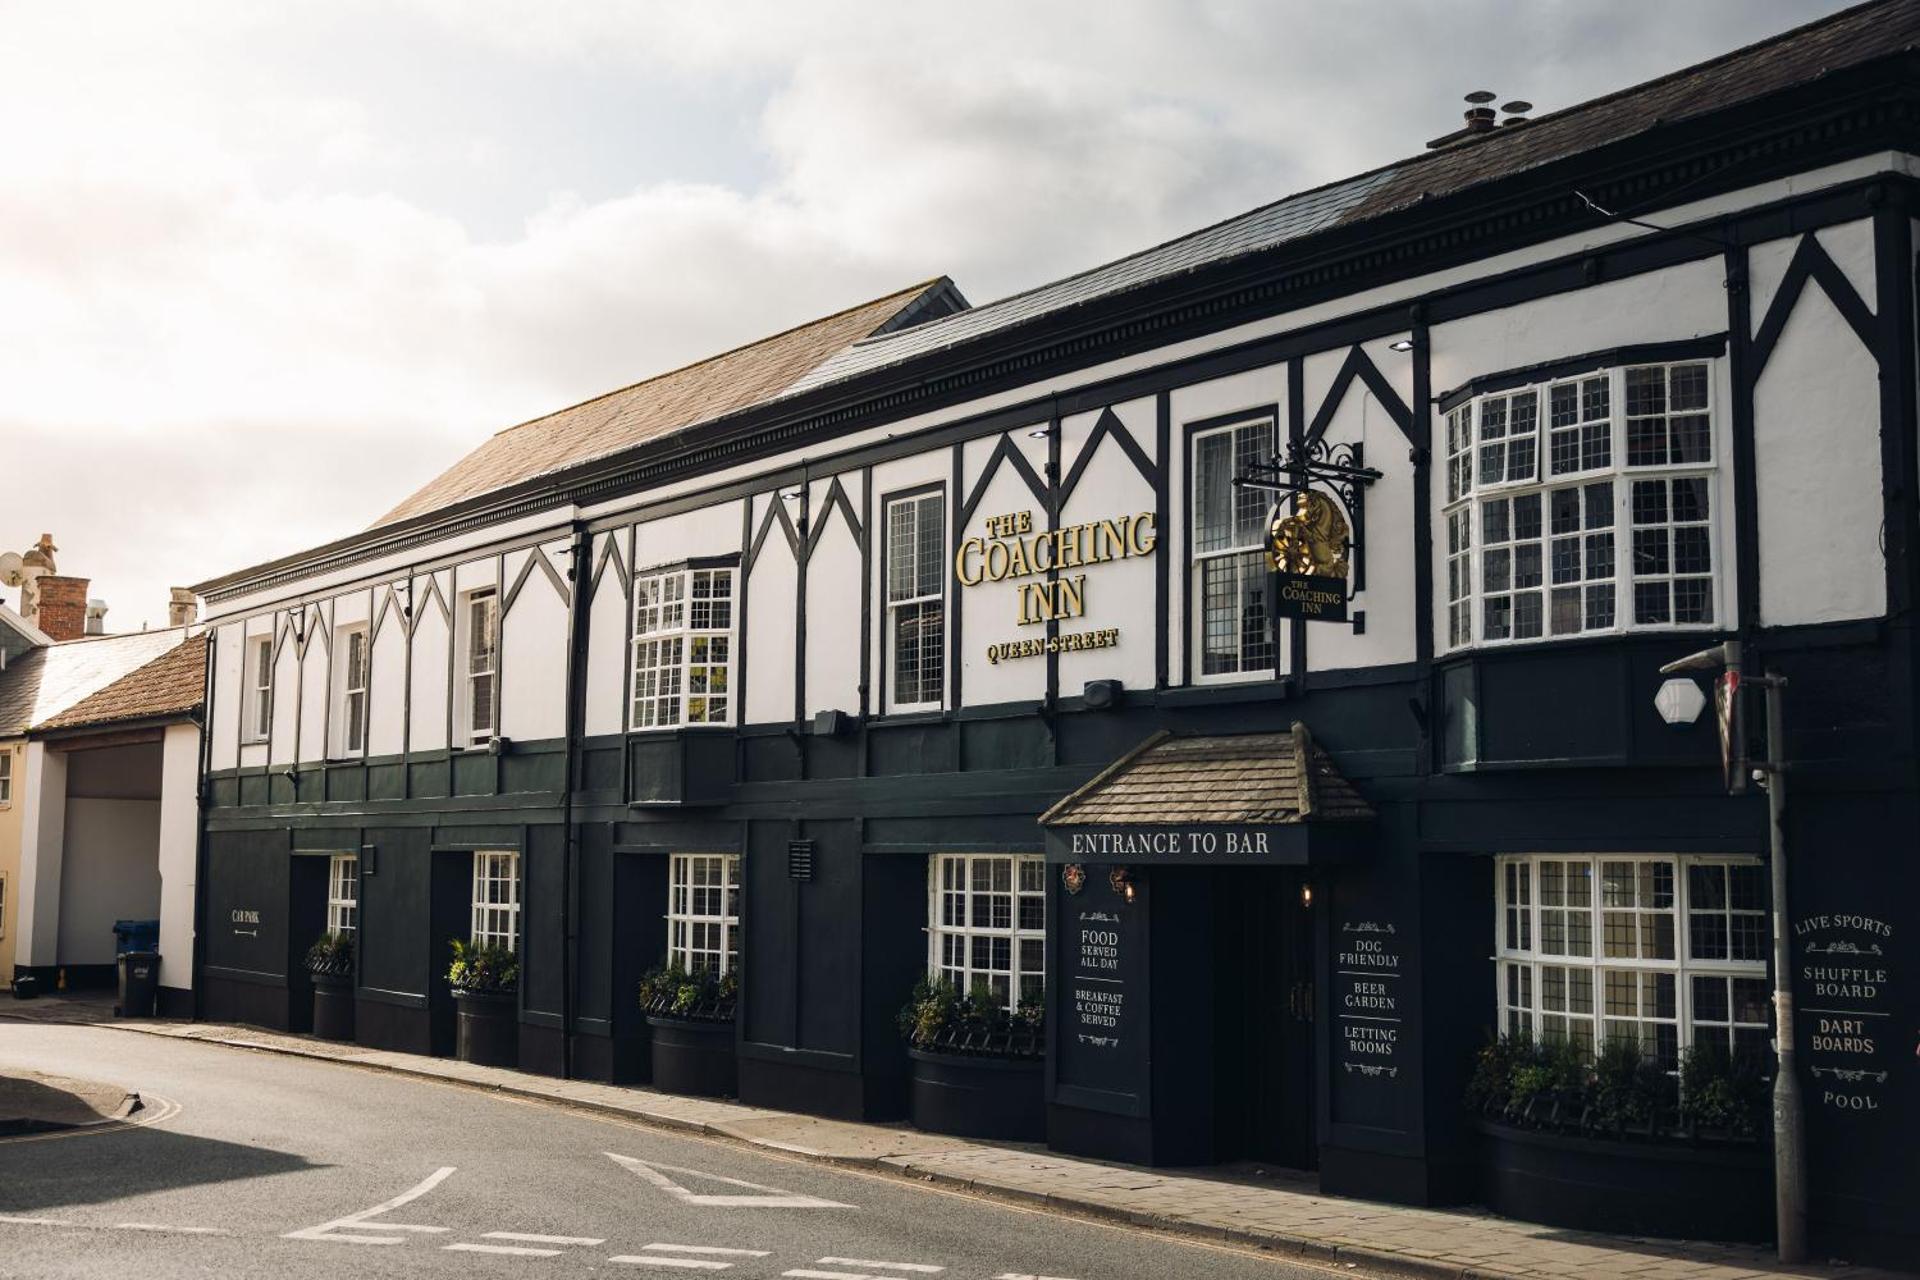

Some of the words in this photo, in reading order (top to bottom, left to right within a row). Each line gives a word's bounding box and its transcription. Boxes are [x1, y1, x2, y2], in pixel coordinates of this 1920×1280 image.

[986, 510, 1032, 540] THE
[956, 511, 1157, 587] COACHING
[1291, 581, 1308, 589] THE
[1017, 574, 1086, 626] INN
[1282, 586, 1341, 605] COACHING
[1302, 602, 1322, 613] INN
[987, 638, 1045, 664] QUEEN
[1049, 628, 1119, 653] STREET
[1072, 832, 1181, 854] ENTRANCE
[1189, 832, 1217, 854] TO
[1226, 832, 1270, 854] BAR
[1795, 915, 1830, 936] LIVE
[1834, 914, 1892, 937] SPORTS
[1082, 929, 1118, 946] FOOD
[1081, 945, 1117, 957] SERVED
[1356, 940, 1382, 953] DOG
[1081, 957, 1098, 968] ALL
[1100, 958, 1119, 970] DAY
[1339, 953, 1399, 967] FRIENDLY
[1803, 966, 1887, 983] SHUFFLE
[1354, 982, 1385, 995] BEER
[1815, 983, 1876, 999] BOARD
[1075, 989, 1124, 1005] BREAKFAST
[1345, 995, 1395, 1009] GARDEN
[1076, 1002, 1083, 1011] &
[1085, 1002, 1121, 1016] COFFEE
[1081, 1014, 1116, 1027] SERVED
[1820, 1019, 1864, 1035] DART
[1344, 1026, 1397, 1042] LETTING
[1350, 1040, 1392, 1055] ROOMS
[1812, 1035, 1874, 1054] BOARDS
[1823, 1091, 1878, 1110] POOL
